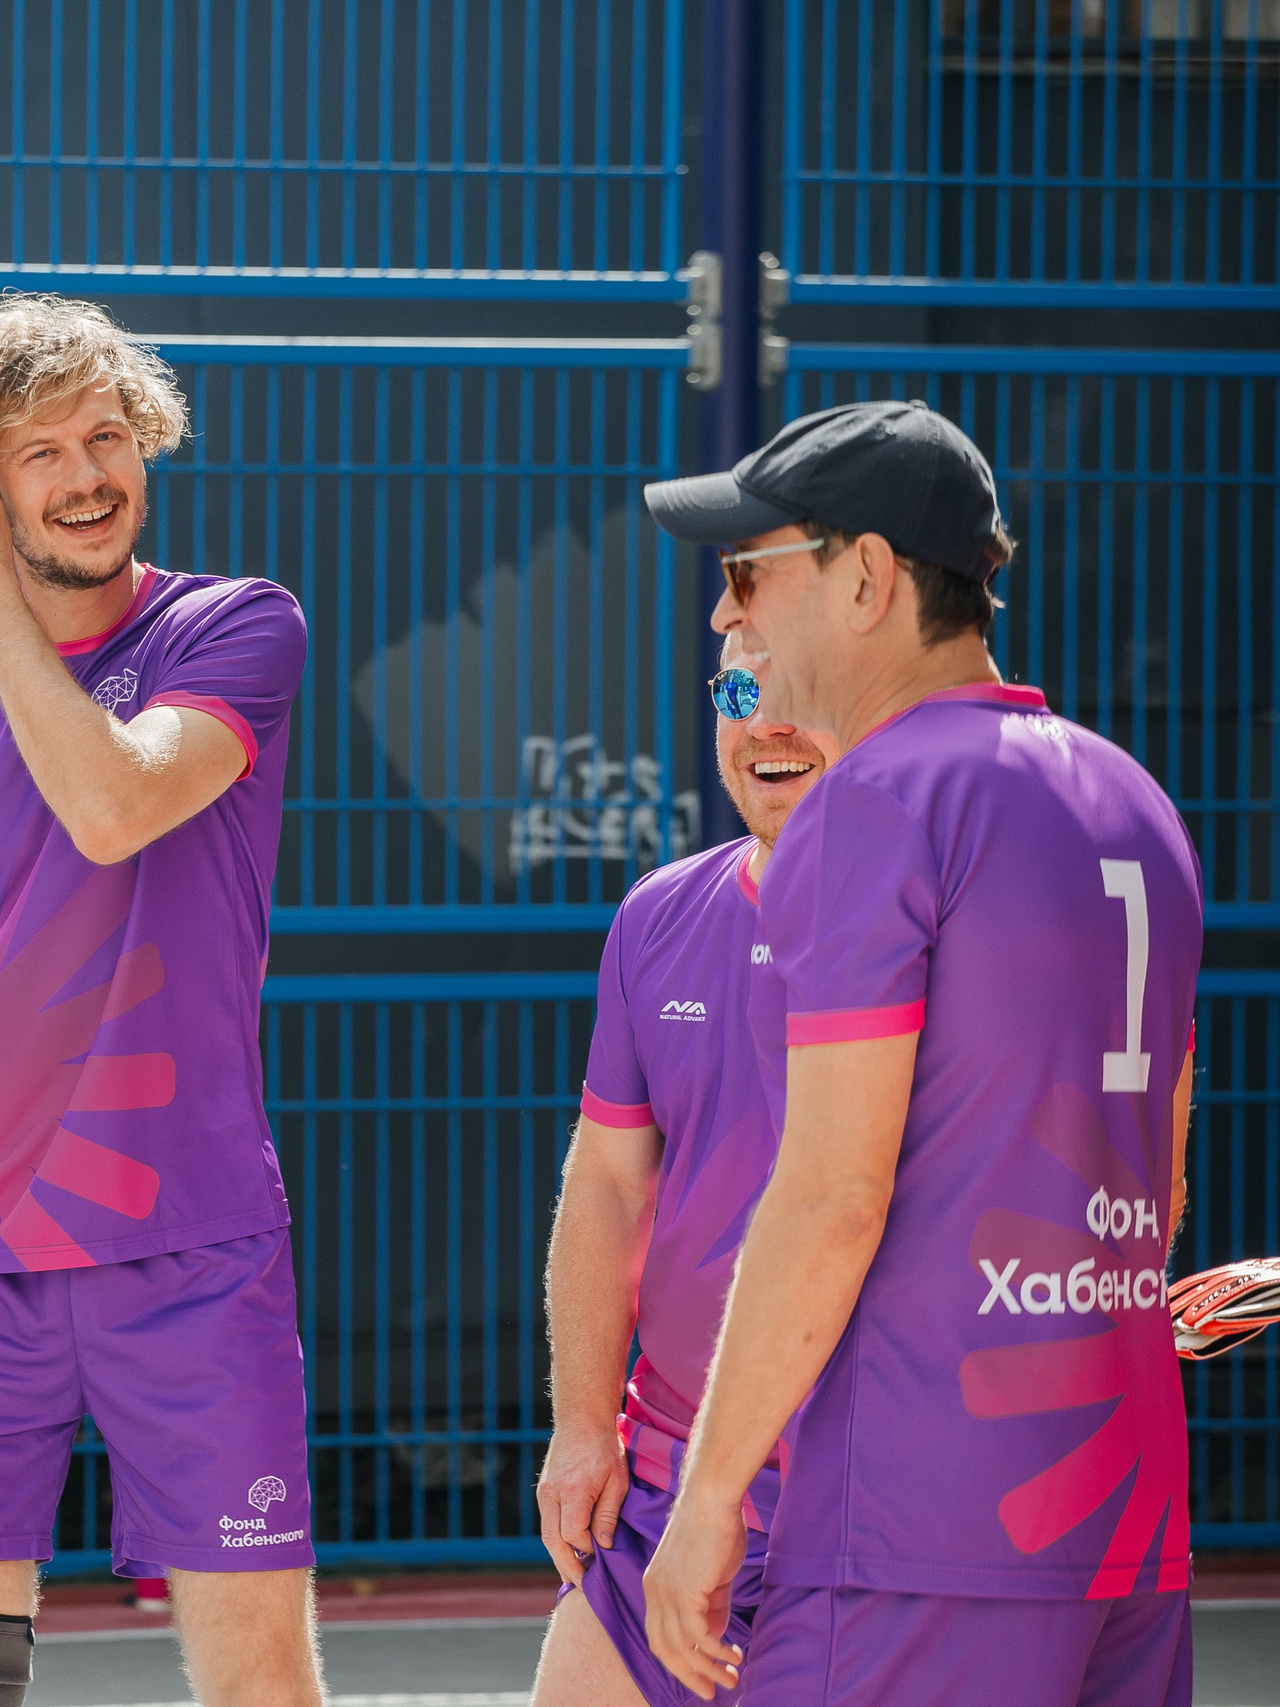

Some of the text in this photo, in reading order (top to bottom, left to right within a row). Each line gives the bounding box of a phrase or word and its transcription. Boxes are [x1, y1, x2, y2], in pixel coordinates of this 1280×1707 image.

[1099, 857, 1152, 1093] 1
[1086, 1184, 1162, 1248] Фон
[219, 1515, 267, 1531] Фонд
[220, 1529, 304, 1548] Хабенского
